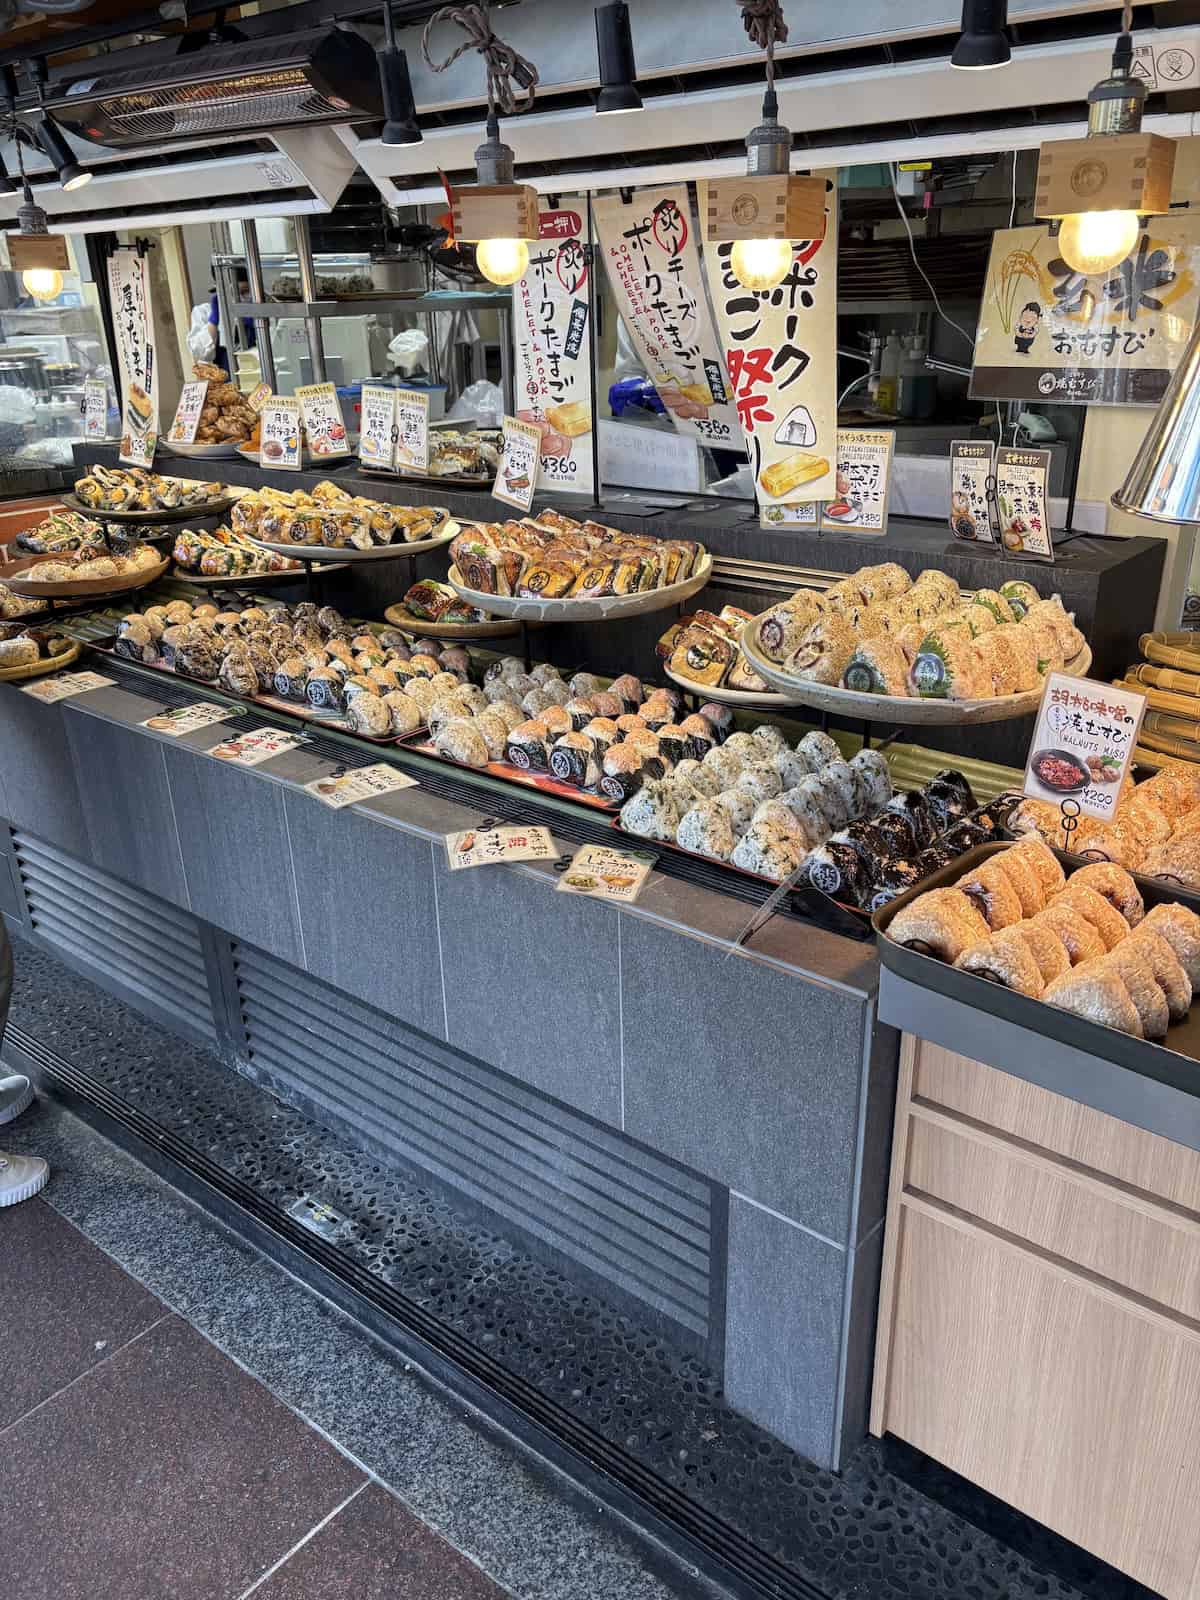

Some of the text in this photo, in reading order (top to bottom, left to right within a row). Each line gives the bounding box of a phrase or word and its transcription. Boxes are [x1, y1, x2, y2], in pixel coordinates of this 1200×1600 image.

[559, 238, 584, 295] 炙り
[520, 279, 537, 337] OMELET
[623, 217, 700, 370] ポークたまご
[528, 247, 575, 404] ポークたまご
[1051, 326, 1156, 357] おむすび
[539, 455, 577, 475] ¥360
[1062, 711, 1131, 744] 焼むすび
[1103, 746, 1125, 760] MISO
[1081, 785, 1113, 805] ¥200
